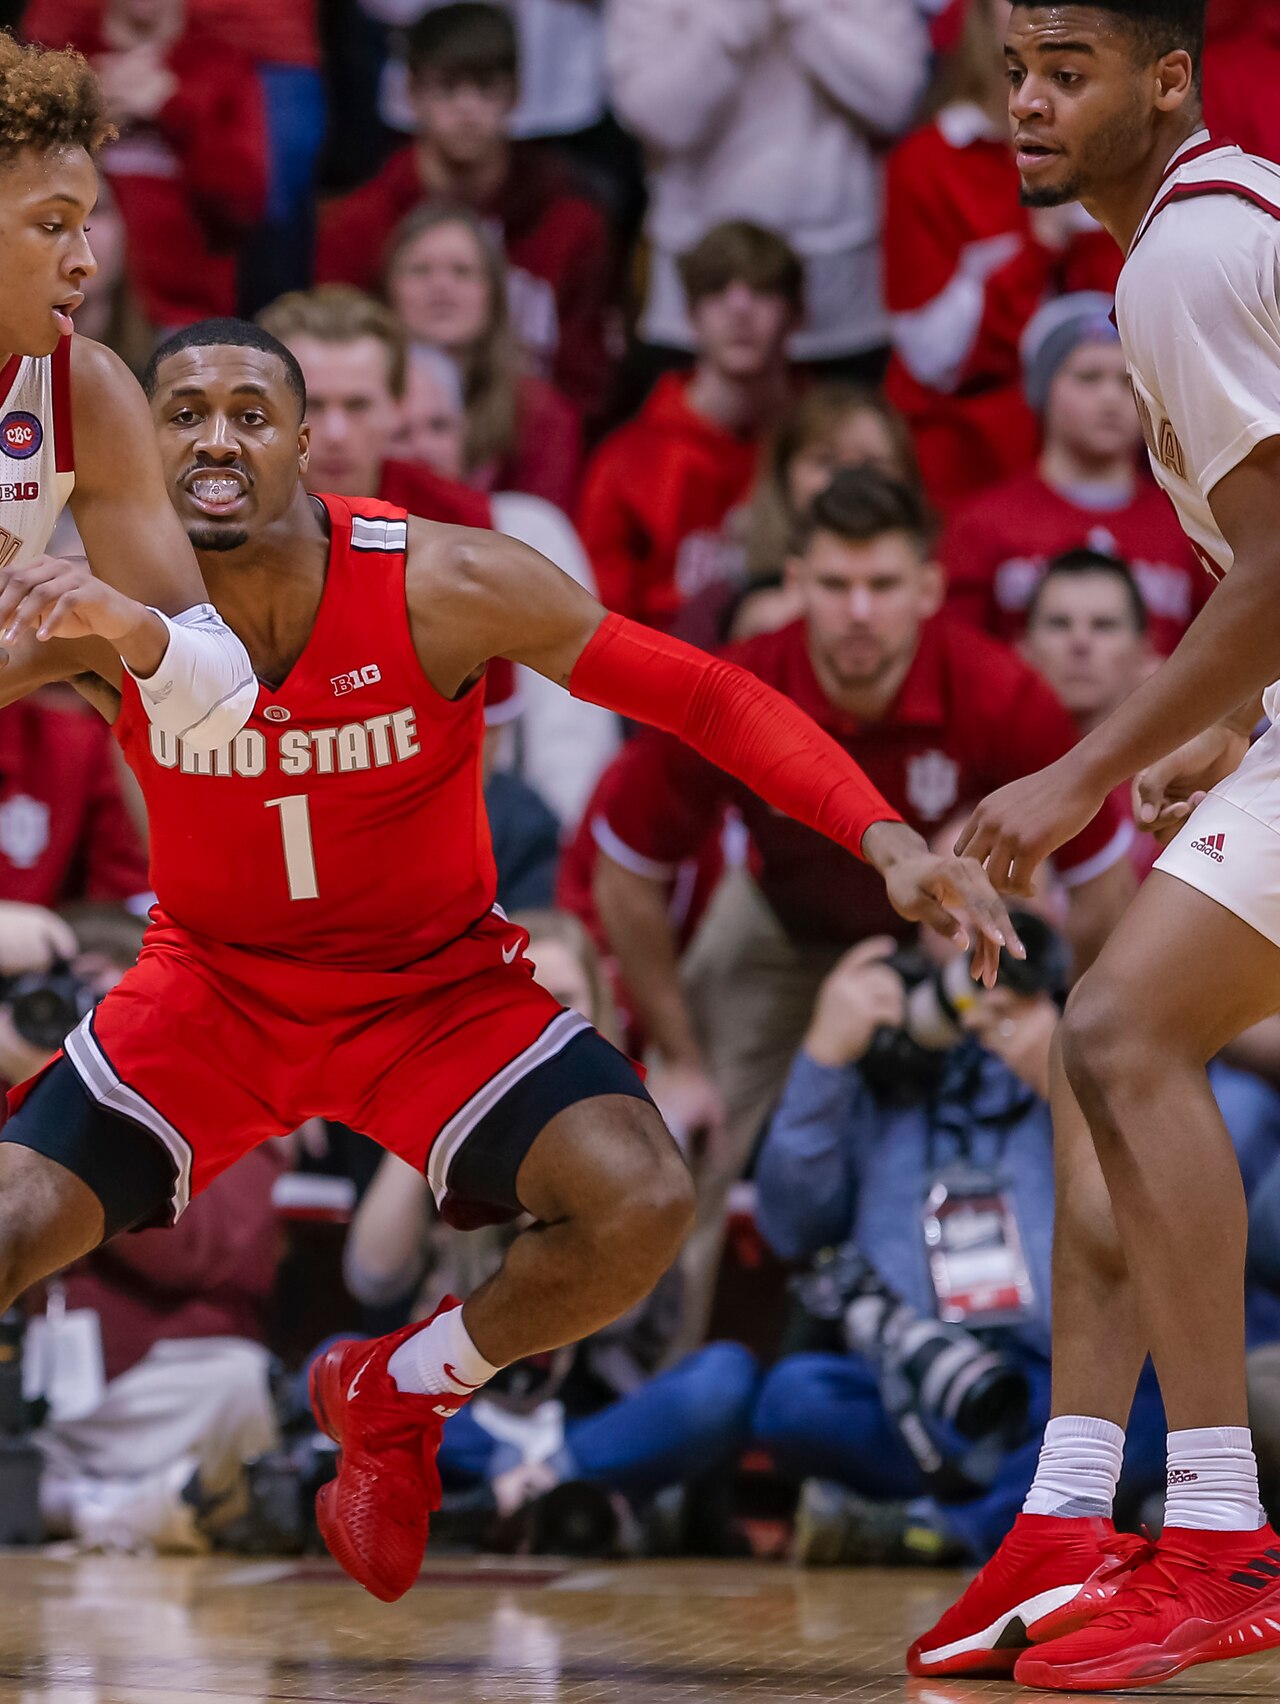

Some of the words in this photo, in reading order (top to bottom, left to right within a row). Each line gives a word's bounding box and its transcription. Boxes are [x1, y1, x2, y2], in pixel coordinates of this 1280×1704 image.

[6, 426, 33, 444] CBC
[279, 705, 421, 776] STATE
[263, 793, 321, 901] 1
[1190, 840, 1225, 863] adidas
